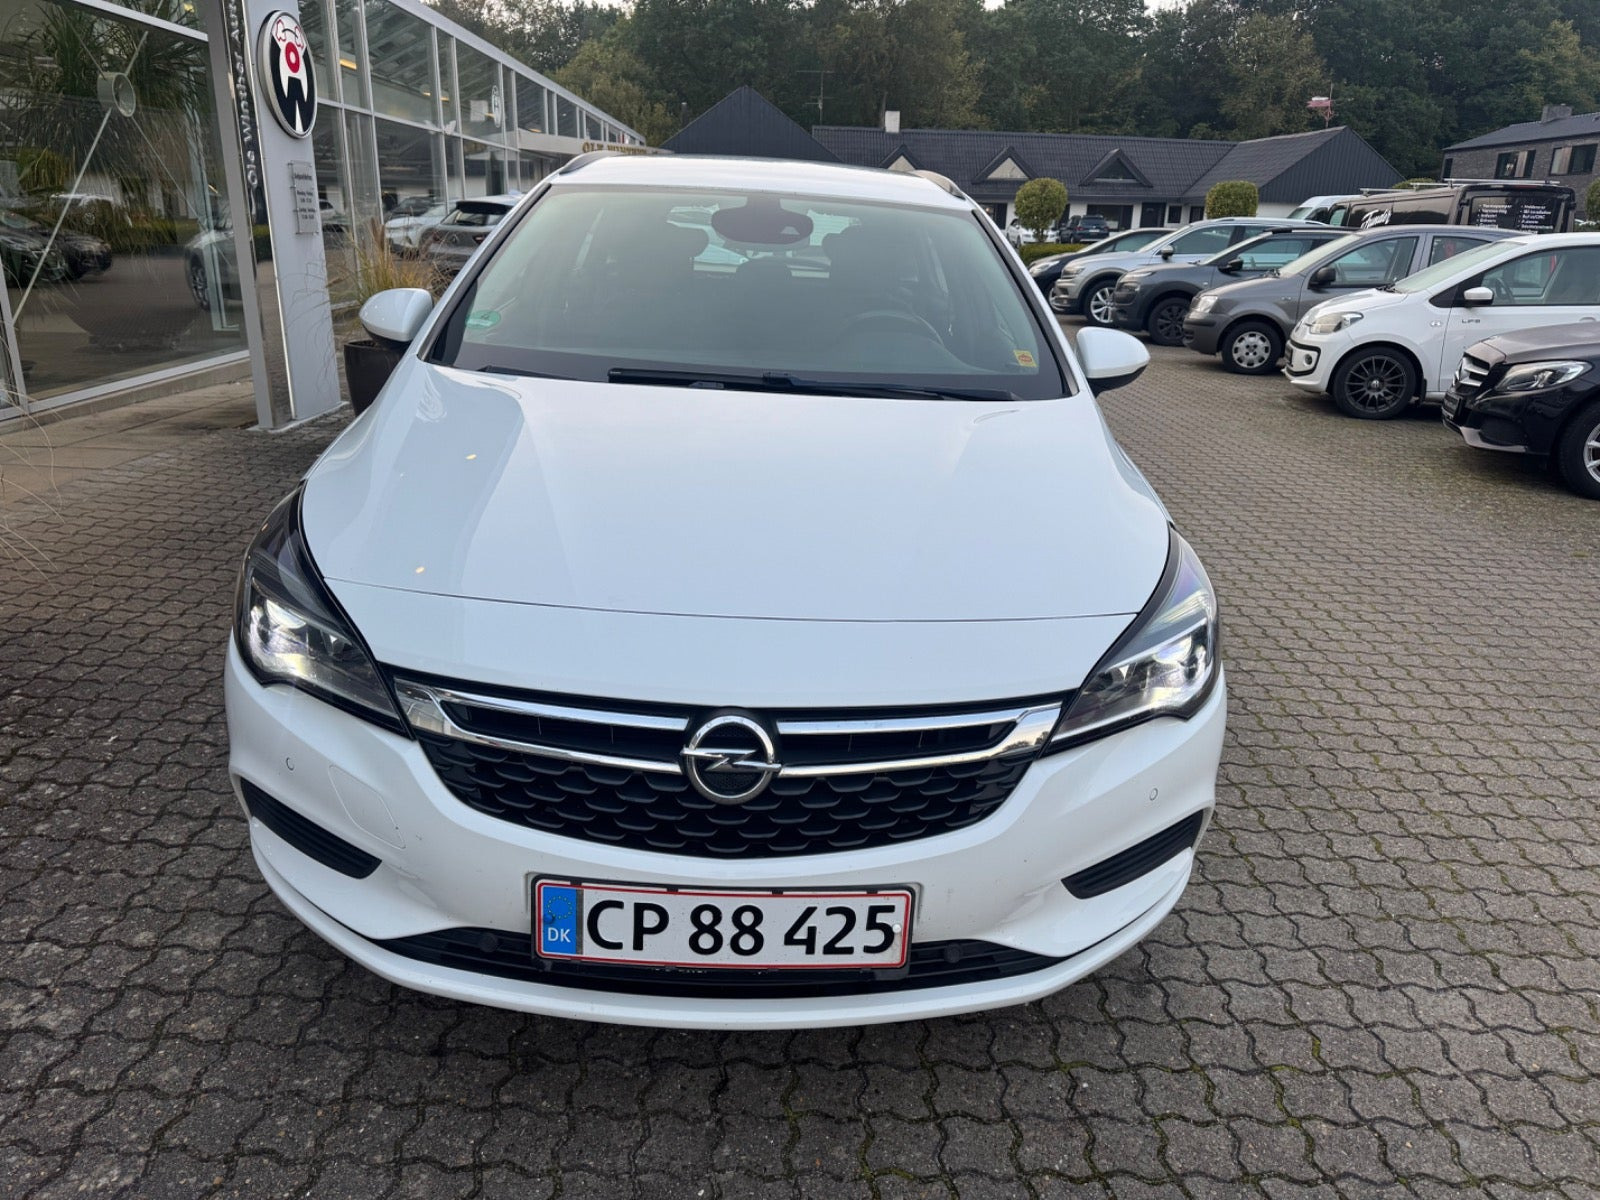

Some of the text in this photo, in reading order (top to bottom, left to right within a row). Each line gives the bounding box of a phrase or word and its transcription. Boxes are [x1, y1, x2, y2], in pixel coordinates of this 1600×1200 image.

[547, 927, 571, 943] DK
[586, 899, 896, 957] CP 88 425
